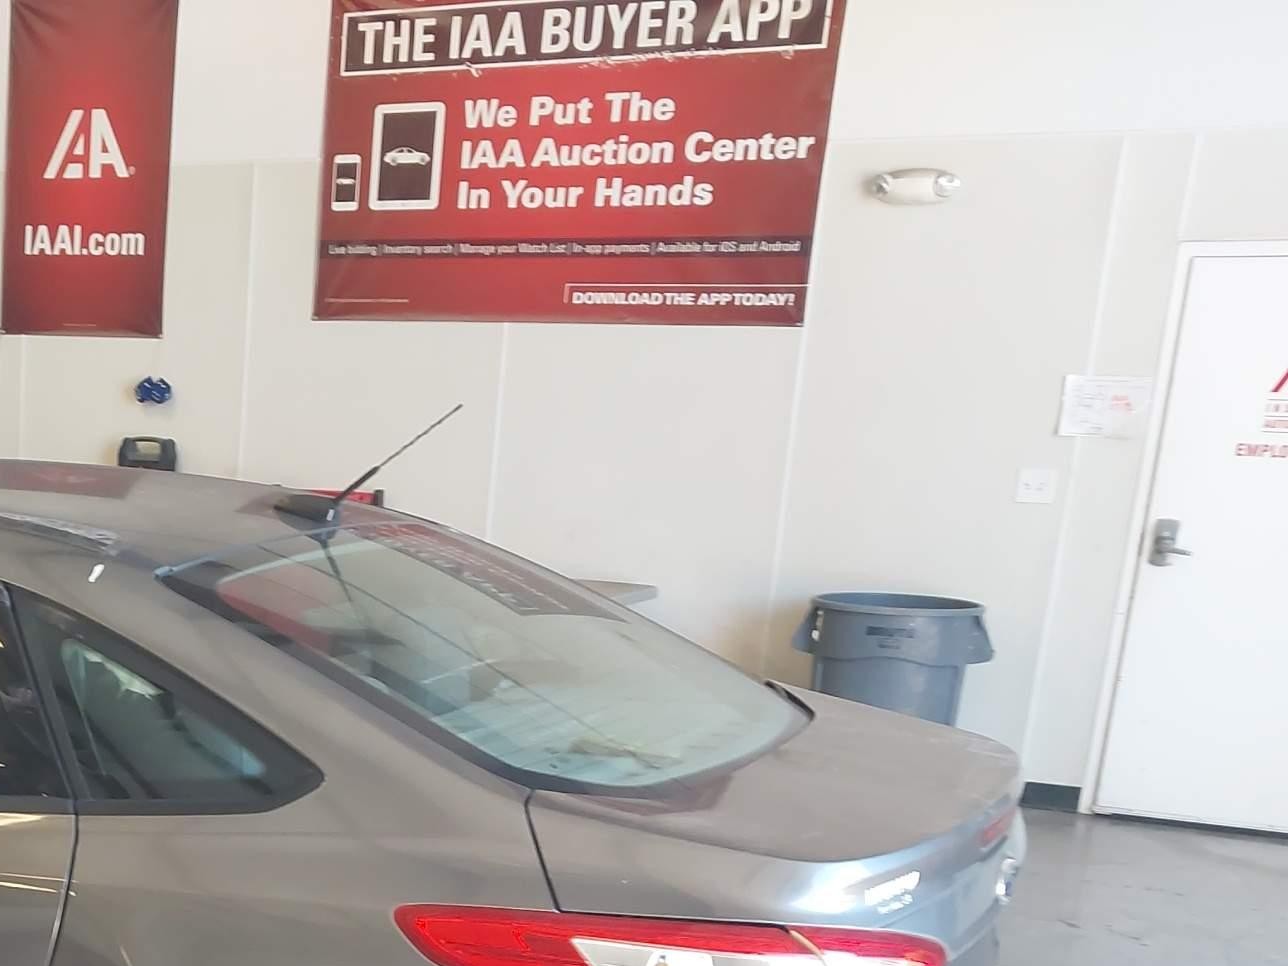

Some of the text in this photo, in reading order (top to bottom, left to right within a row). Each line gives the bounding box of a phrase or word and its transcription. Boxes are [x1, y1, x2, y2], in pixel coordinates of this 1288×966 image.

[357, 0, 812, 64] THE IAA BUYER APP
[464, 92, 676, 129] We Put The
[460, 131, 816, 170] IAA Auction Center
[457, 175, 714, 209] In Your Hands
[23, 224, 146, 256] IAAI.com
[572, 291, 796, 306] DOWNLOAD THE APP TODAY!
